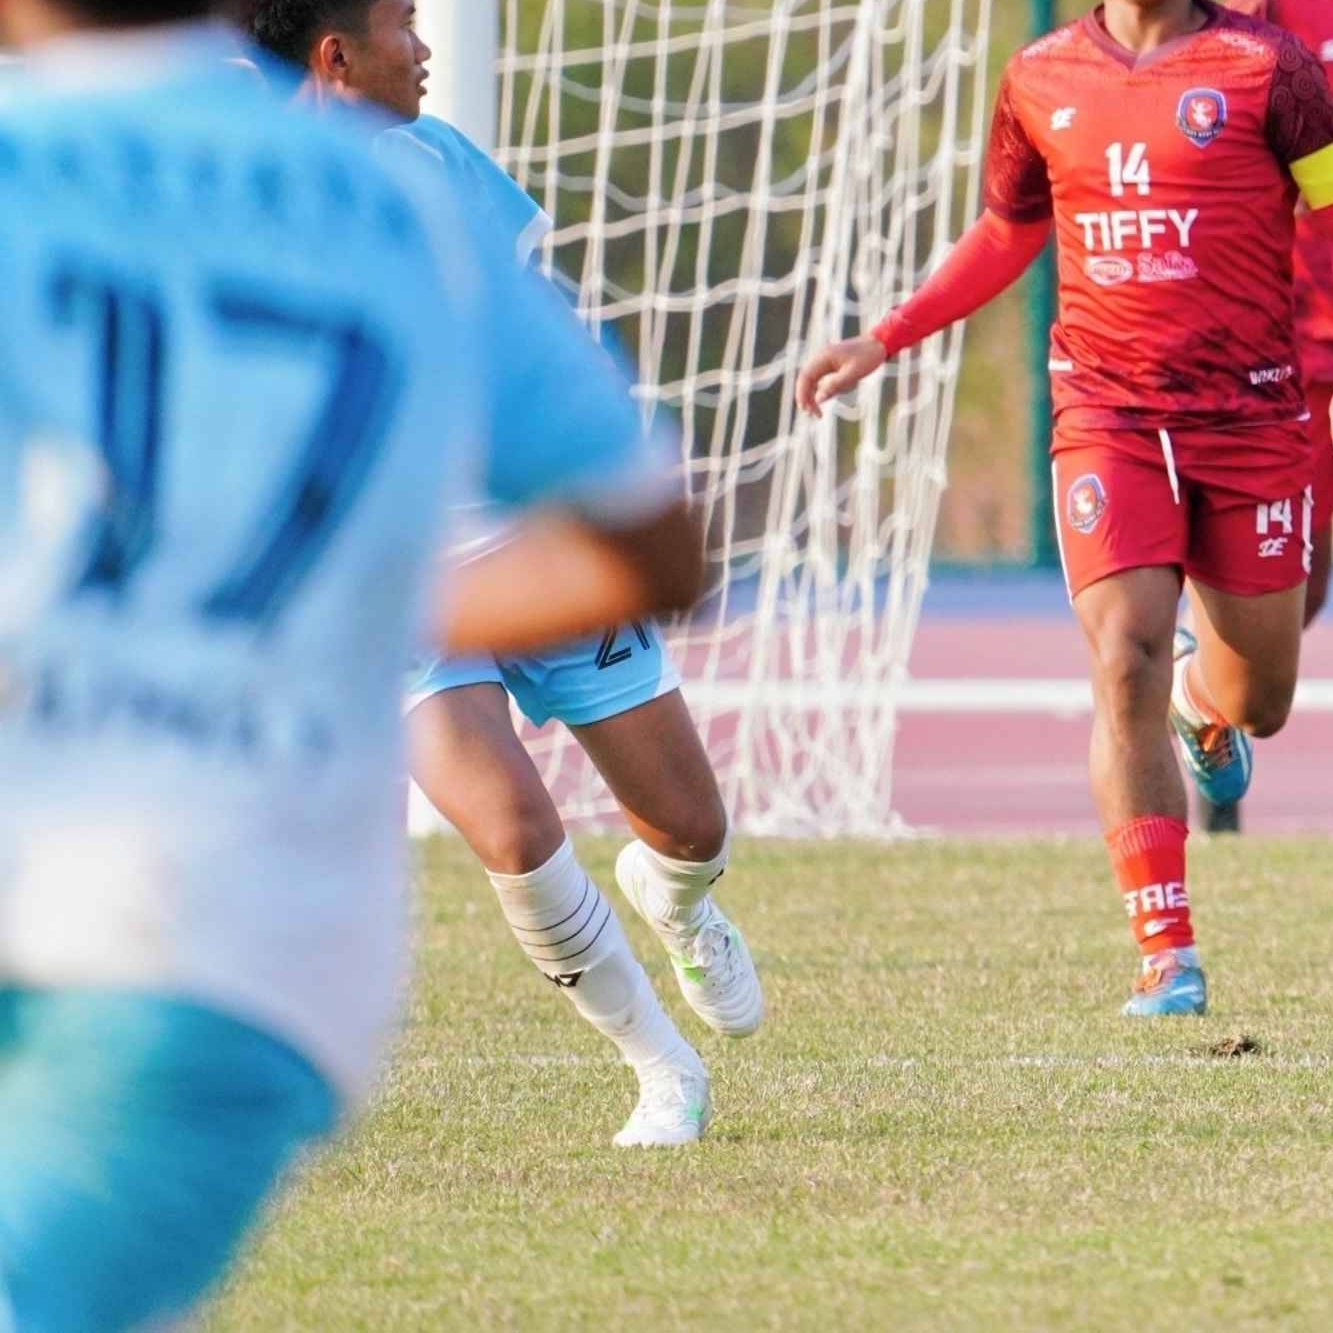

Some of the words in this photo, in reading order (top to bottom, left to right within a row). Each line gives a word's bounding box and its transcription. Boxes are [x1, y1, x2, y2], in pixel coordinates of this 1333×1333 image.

[1105, 142, 1150, 197] 14
[1075, 208, 1199, 252] TIFFY
[45, 264, 402, 626] 17
[1256, 498, 1293, 534] 14
